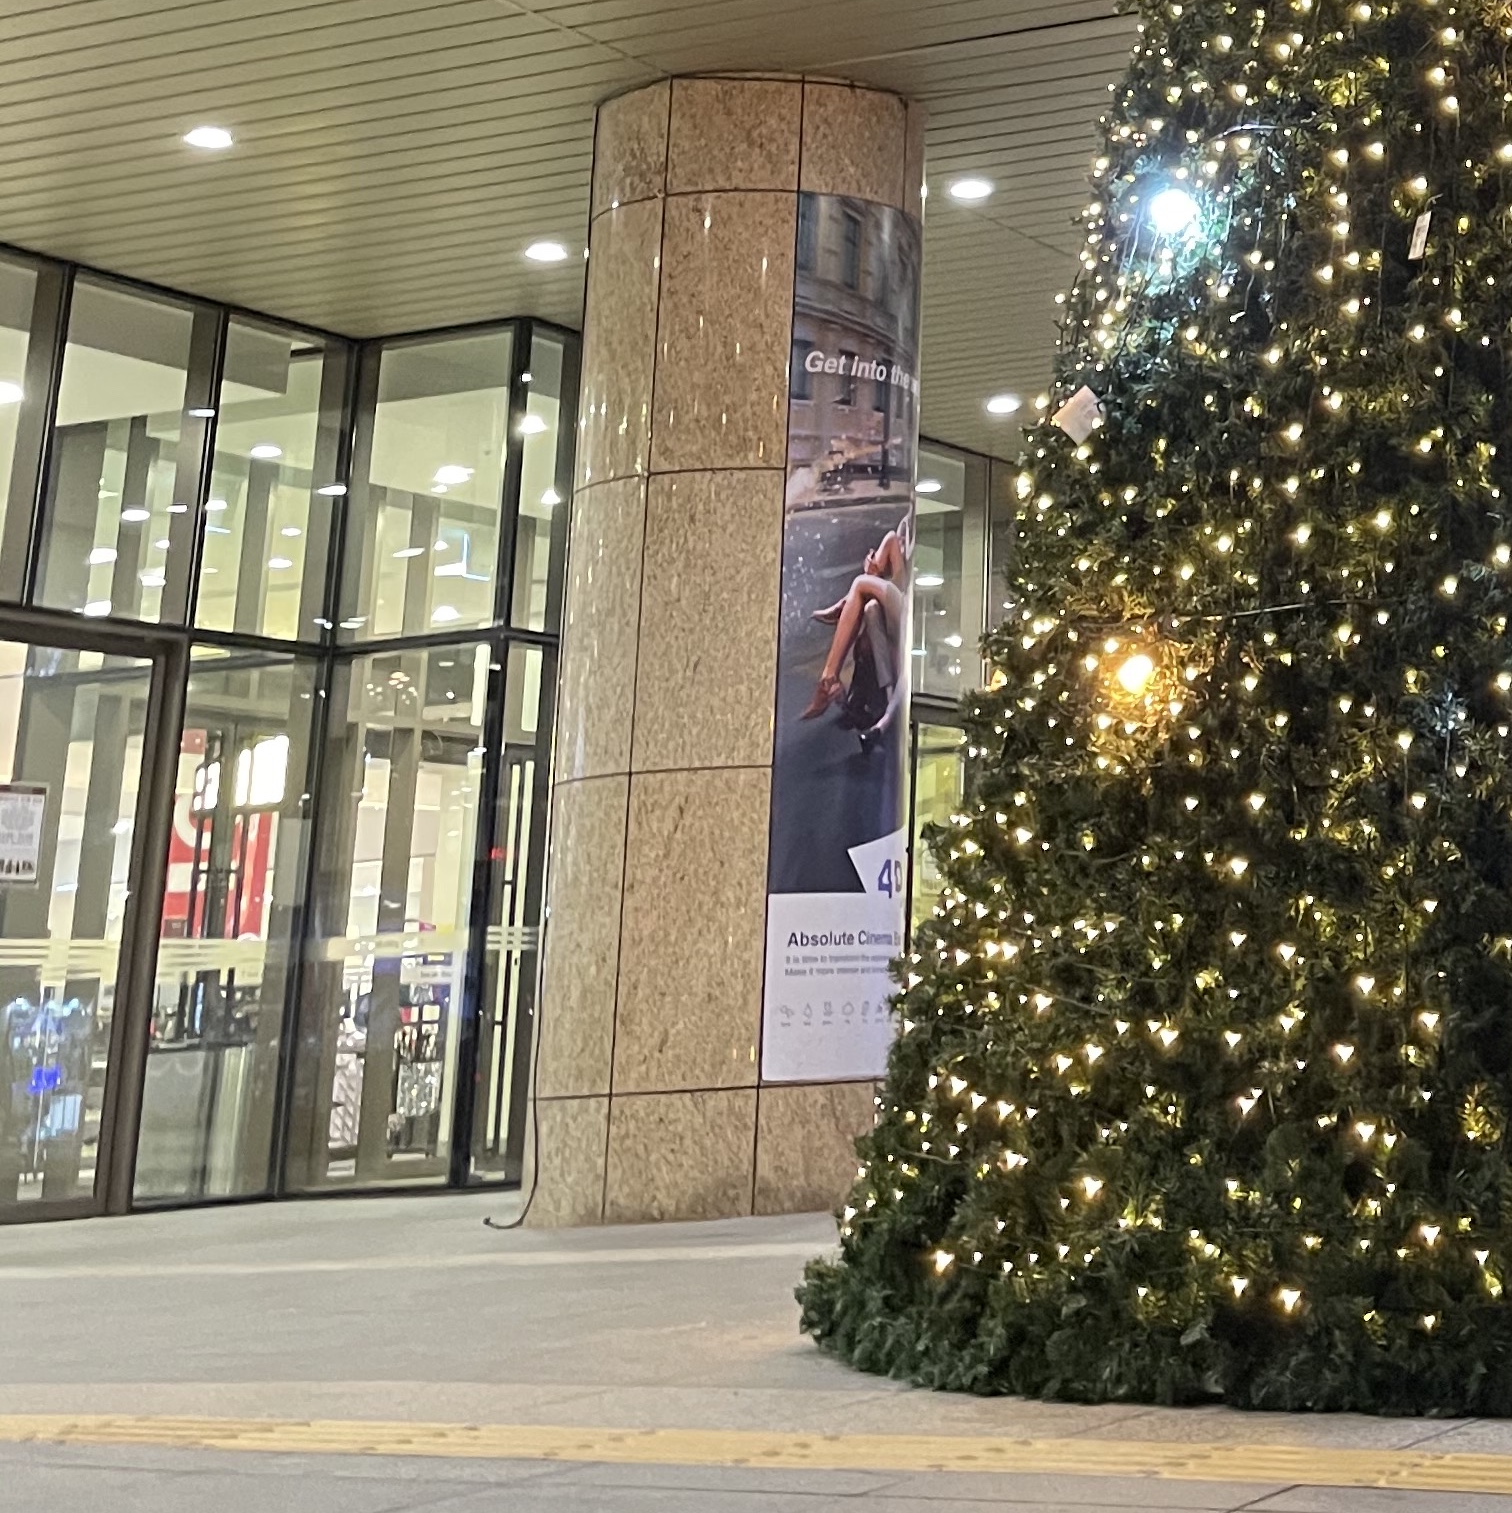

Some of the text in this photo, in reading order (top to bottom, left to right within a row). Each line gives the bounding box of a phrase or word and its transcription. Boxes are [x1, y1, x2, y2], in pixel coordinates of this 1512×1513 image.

[805, 350, 846, 375] Get
[850, 354, 887, 381] into
[891, 364, 910, 389] the
[787, 930, 855, 948] Absolute
